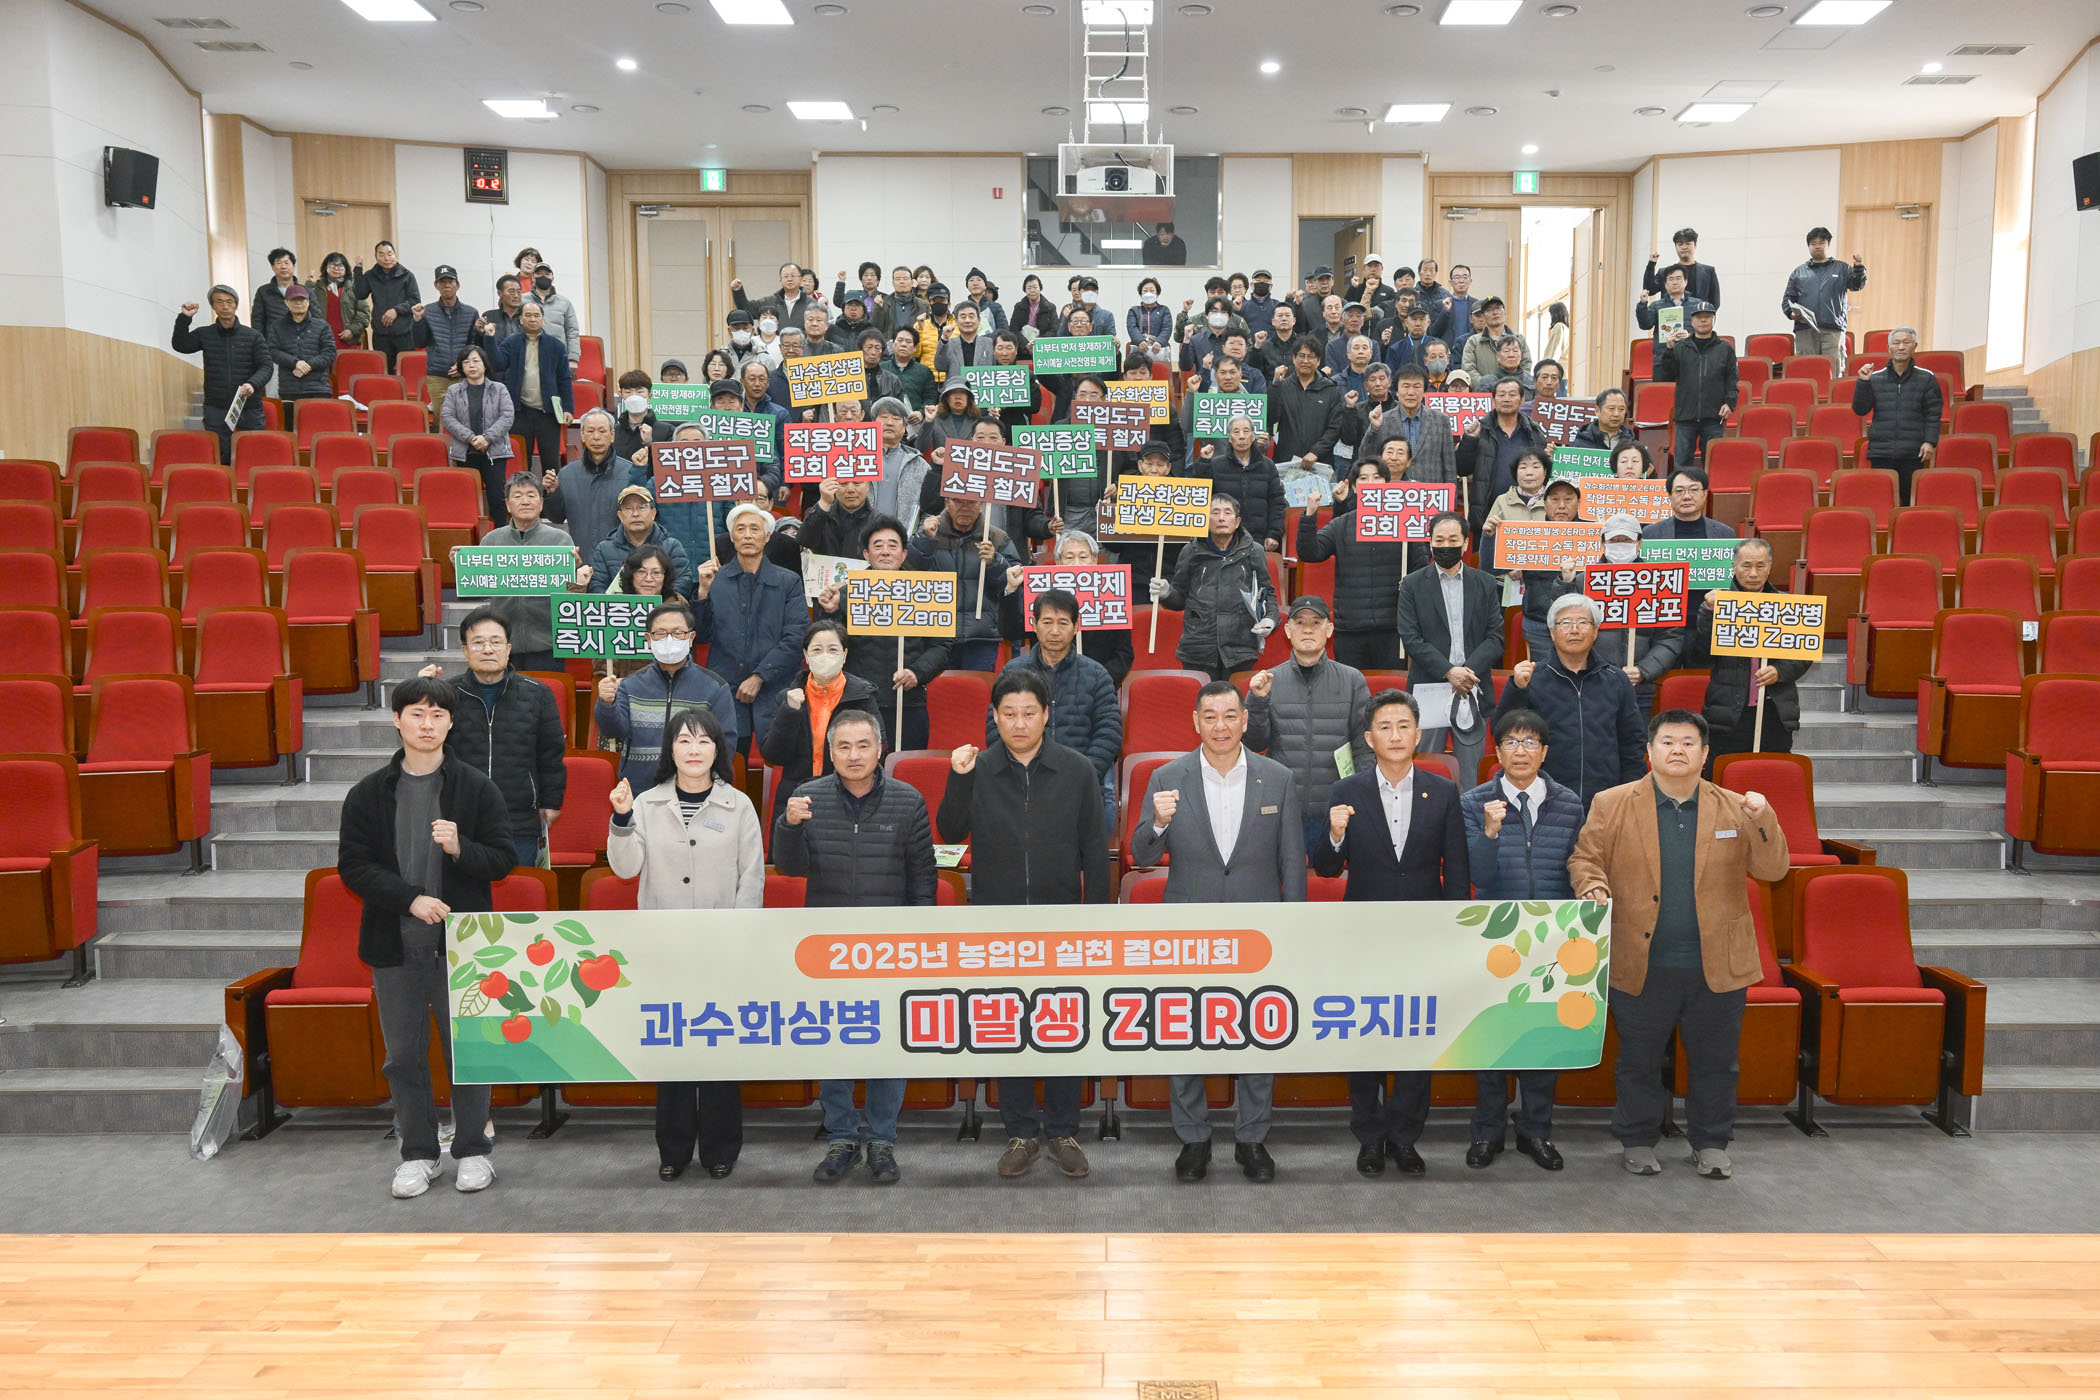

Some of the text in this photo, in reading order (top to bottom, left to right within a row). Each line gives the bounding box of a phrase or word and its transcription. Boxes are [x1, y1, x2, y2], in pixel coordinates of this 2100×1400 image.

[1036, 341, 1112, 353] 나부터 먼저 방제하기!
[789, 358, 862, 380] 과수화상병
[965, 369, 1026, 387] 의심증상
[652, 389, 707, 400] 먼저 방제하기!
[792, 380, 864, 400] 발생 Zero
[999, 388, 1029, 405] 신고
[1075, 405, 1146, 426] 작업도구
[1198, 398, 1263, 416] 의심증상
[1428, 396, 1493, 413] 적용약제
[1537, 401, 1599, 422] 작업도구
[700, 414, 771, 439] 의심증상
[1195, 417, 1228, 435] 즉시
[788, 427, 877, 453] 적용약제
[1018, 431, 1091, 452] 의심증상
[1112, 428, 1147, 447] 철저
[658, 445, 750, 471] 작업도구
[789, 454, 879, 478] 3회 살포
[950, 445, 1036, 477] 작업도구
[1058, 453, 1096, 475] 신고
[1553, 453, 1580, 465] 나부터
[1583, 456, 1601, 467] 먼저
[659, 472, 755, 498] 소독 철저
[943, 472, 1035, 504] 소독 철저
[1119, 483, 1209, 506] 과수화상병
[1361, 488, 1449, 512] 적용약제
[1586, 493, 1626, 505] 작업도구
[1628, 495, 1649, 506] 소독
[1101, 505, 1112, 517] 내
[1119, 505, 1155, 526] 발생
[1158, 507, 1206, 528] Zero
[1629, 508, 1647, 519] 3회
[1361, 514, 1434, 538] 3회 살
[1544, 527, 1559, 536] 발생
[1561, 528, 1586, 536] ZERO
[1505, 539, 1549, 551] 작업도구
[1552, 540, 1573, 551] 소독
[1640, 548, 1672, 560] 나부터
[1676, 548, 1697, 560] 먼저
[459, 554, 570, 567] 나부터 먼저 방제하기!
[1506, 553, 1549, 566] 적용약제
[460, 574, 498, 588] 수시예찰
[500, 574, 548, 588] 사전전염원
[1589, 568, 1684, 596] 적용약제
[1689, 568, 1726, 581] 전전염원
[849, 578, 953, 603] 과수화상병
[558, 602, 654, 627] 의심증상
[850, 603, 952, 627] 발생 Zero
[1078, 600, 1128, 627] 살포
[1634, 597, 1682, 625] 살포
[1715, 600, 1823, 627] 과수화상병
[556, 629, 604, 654] 즉시
[1715, 624, 1820, 650] 발생 Zero
[828, 937, 1239, 971] 2025년 농업인 실천 결의대회
[640, 990, 1438, 1049] 과수화상병 미발생 ZERO 유지!!
